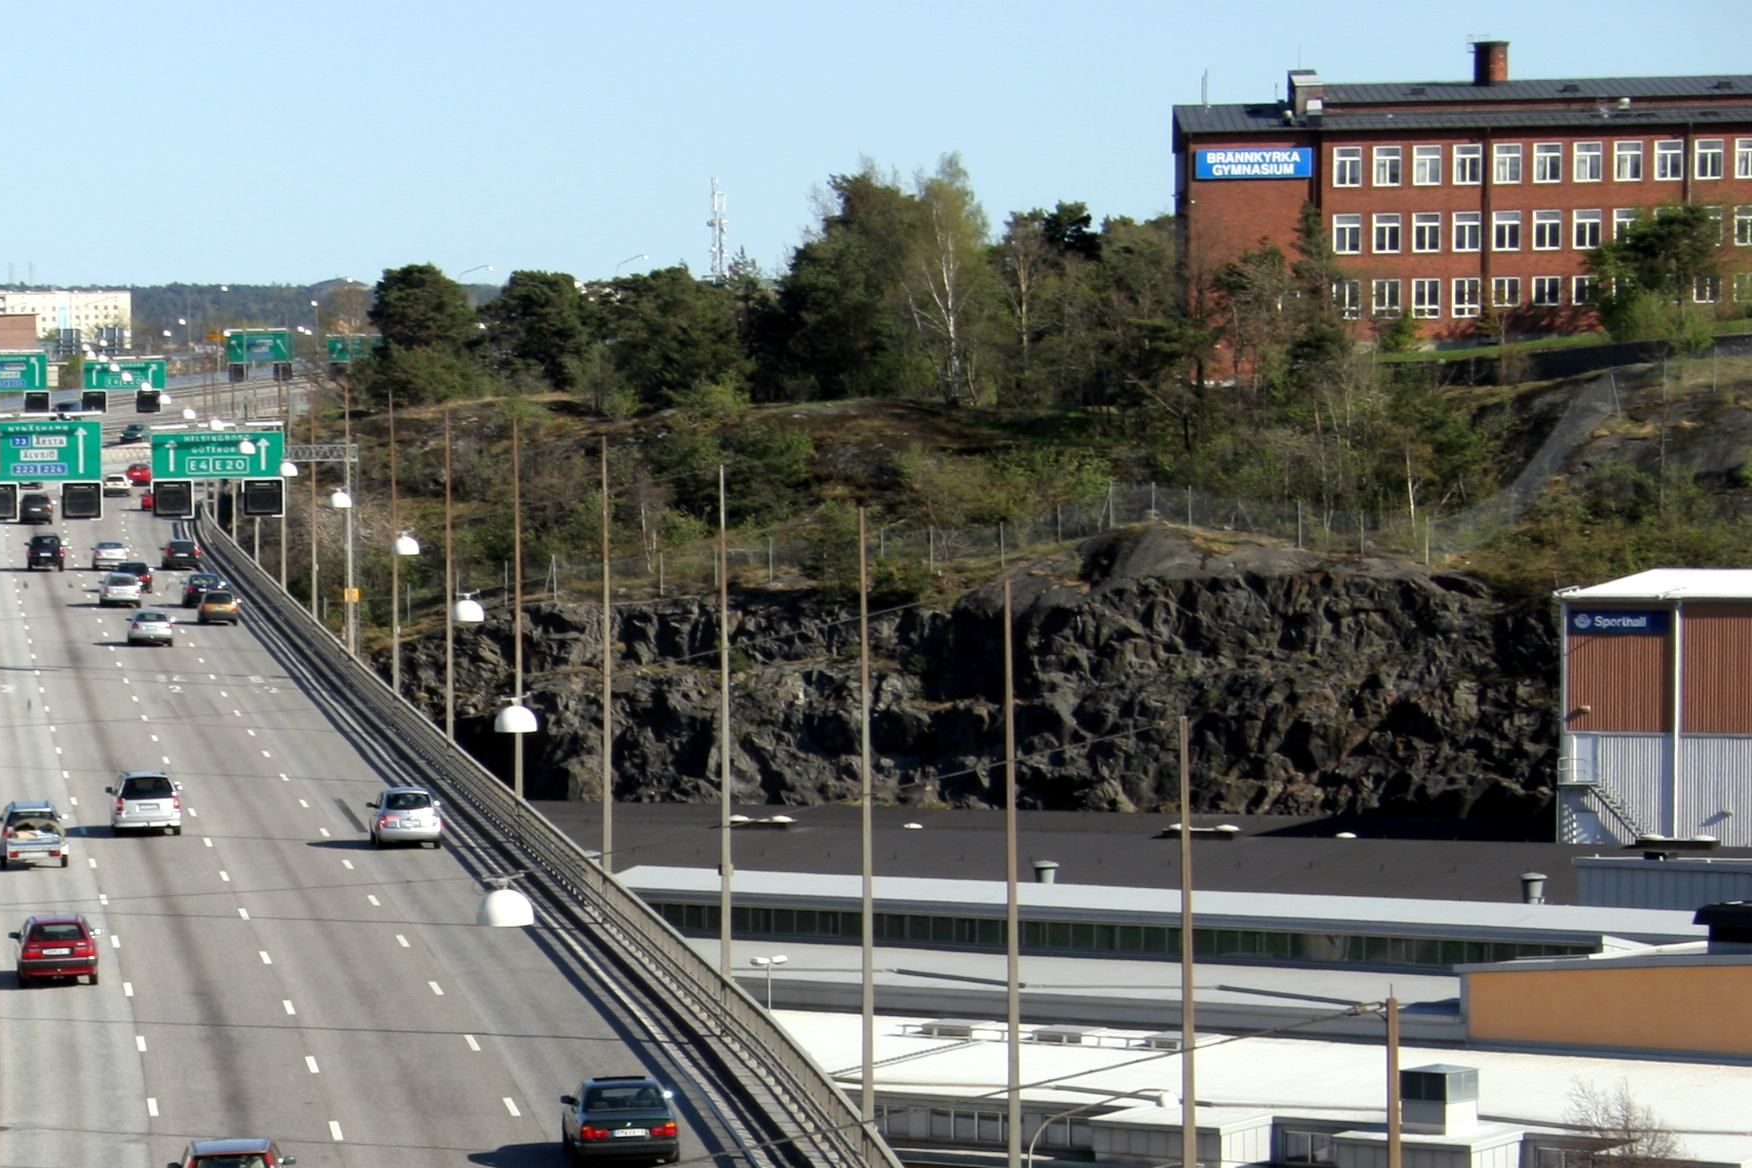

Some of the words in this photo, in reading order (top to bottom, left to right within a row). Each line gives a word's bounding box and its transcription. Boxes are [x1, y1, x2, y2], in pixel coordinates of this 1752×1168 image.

[1206, 151, 1301, 163] BRÄNNKYRKA
[1211, 163, 1295, 176] GYMNASIUM
[34, 436, 65, 446] ÅRSTA
[15, 465, 35, 474] 222
[1593, 615, 1647, 629] Sporthall
